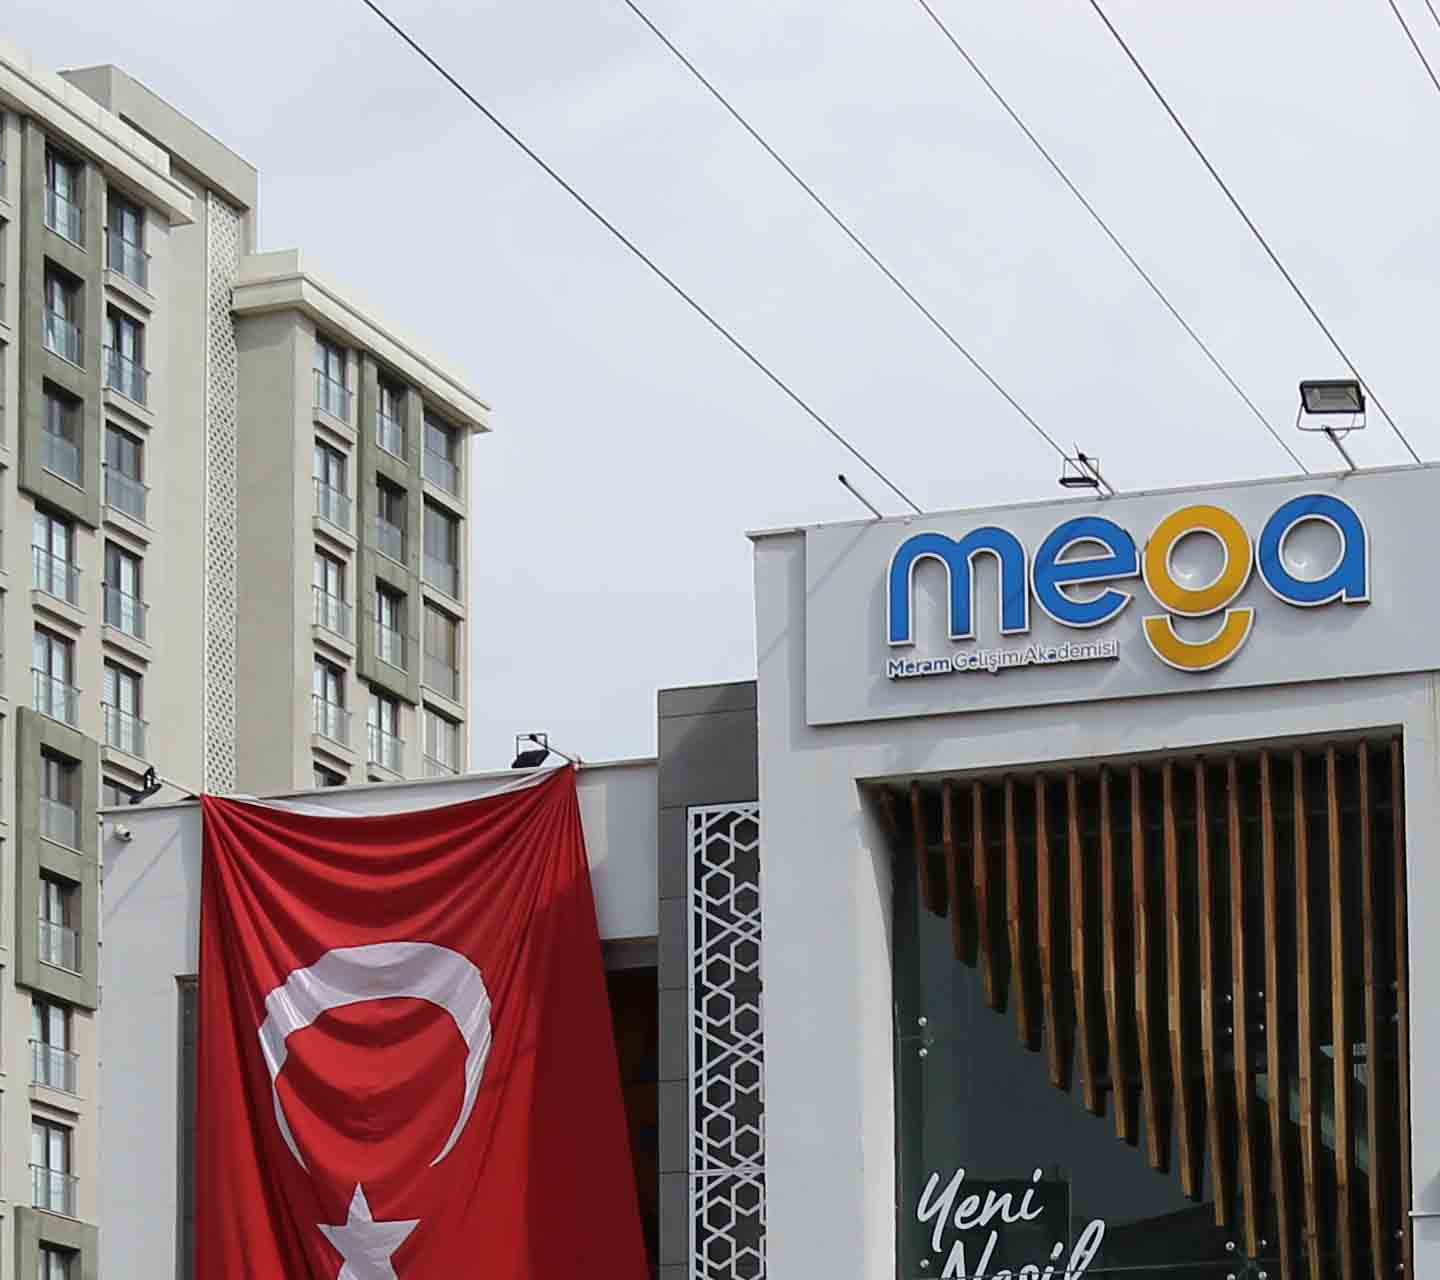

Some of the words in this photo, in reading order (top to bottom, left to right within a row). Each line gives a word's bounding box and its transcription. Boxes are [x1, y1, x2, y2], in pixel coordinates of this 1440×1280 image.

[887, 493, 1371, 672] mega
[888, 658, 951, 678] Meram
[954, 649, 1022, 673] Gelişim
[1023, 640, 1120, 664] Akademisi
[916, 1167, 1044, 1252] Yeni
